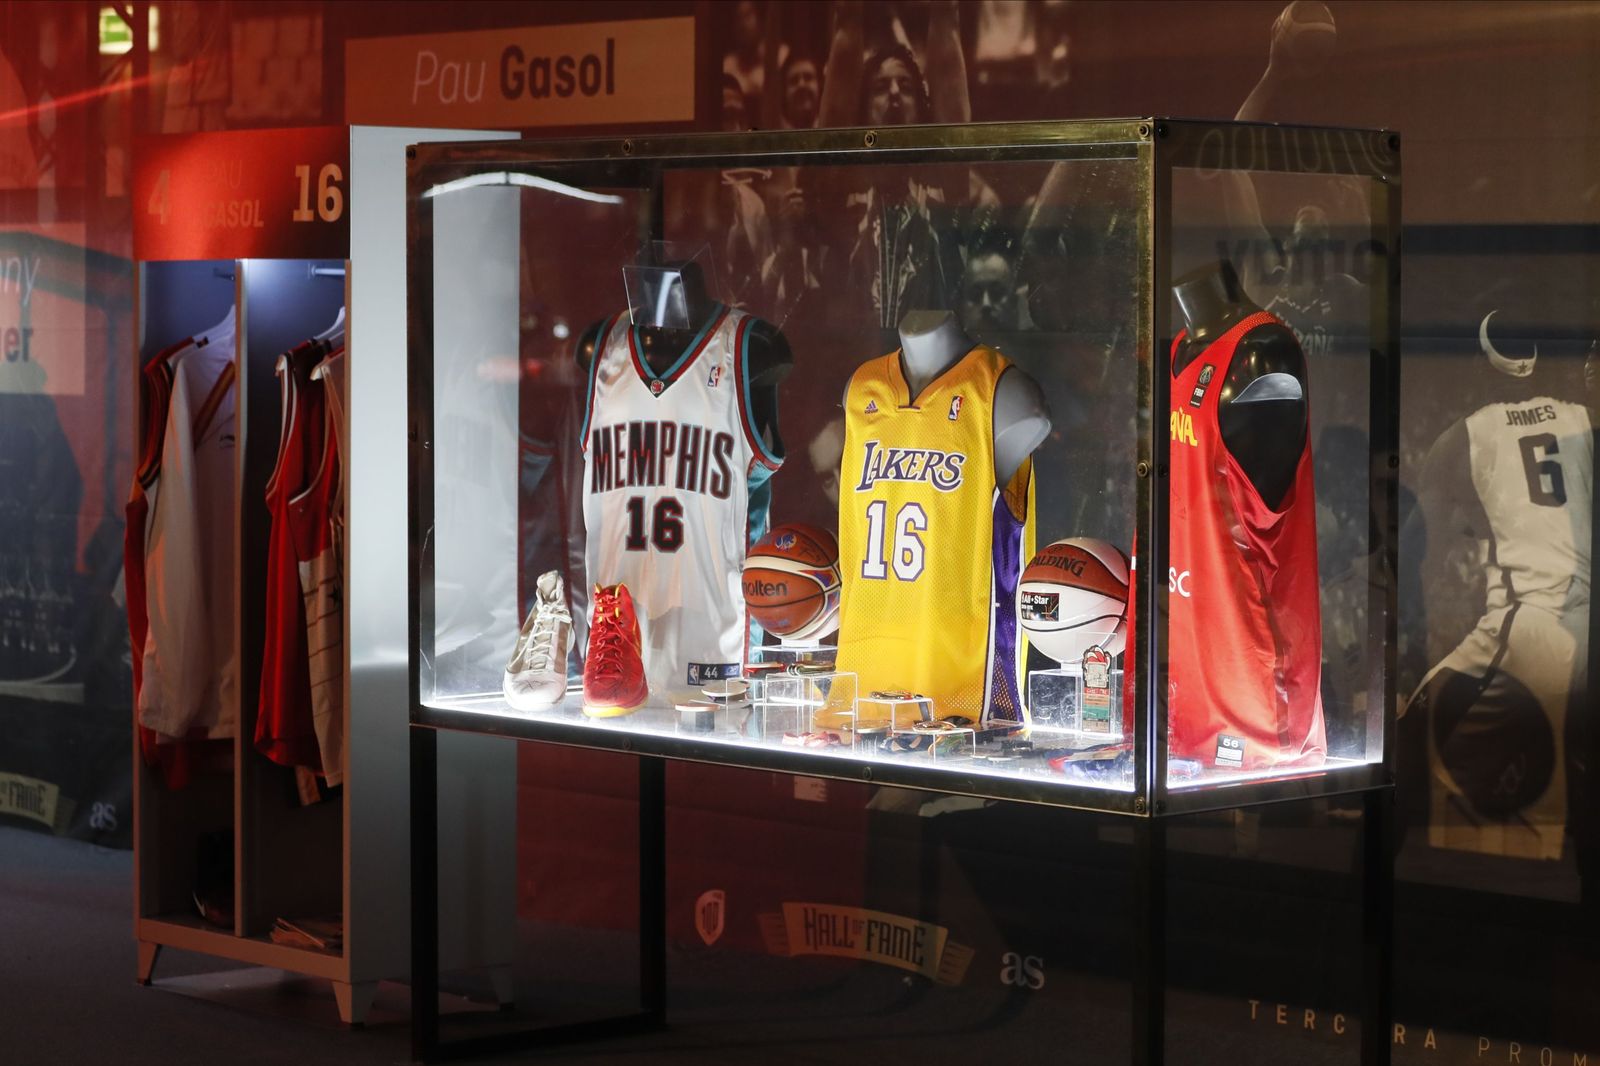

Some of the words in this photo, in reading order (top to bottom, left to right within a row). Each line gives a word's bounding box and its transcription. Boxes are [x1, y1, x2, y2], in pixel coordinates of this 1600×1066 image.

[412, 50, 487, 105] Pau
[500, 38, 616, 100] Gasol
[147, 169, 172, 226] 4
[292, 163, 344, 223] 16
[0, 255, 40, 307] ny
[1505, 404, 1557, 427] JAMES
[590, 419, 735, 500] MEMPHIS
[854, 439, 968, 494] LAKERS
[1517, 431, 1568, 508] 6
[625, 496, 684, 553] 16
[861, 499, 928, 582] 16
[704, 666, 718, 679] 44
[1222, 737, 1240, 749] 56
[89, 801, 118, 832] as
[802, 906, 855, 951] HALL
[865, 918, 927, 967] FAME
[1000, 951, 1046, 990] as
[1248, 1000, 1437, 1050] TERCRA
